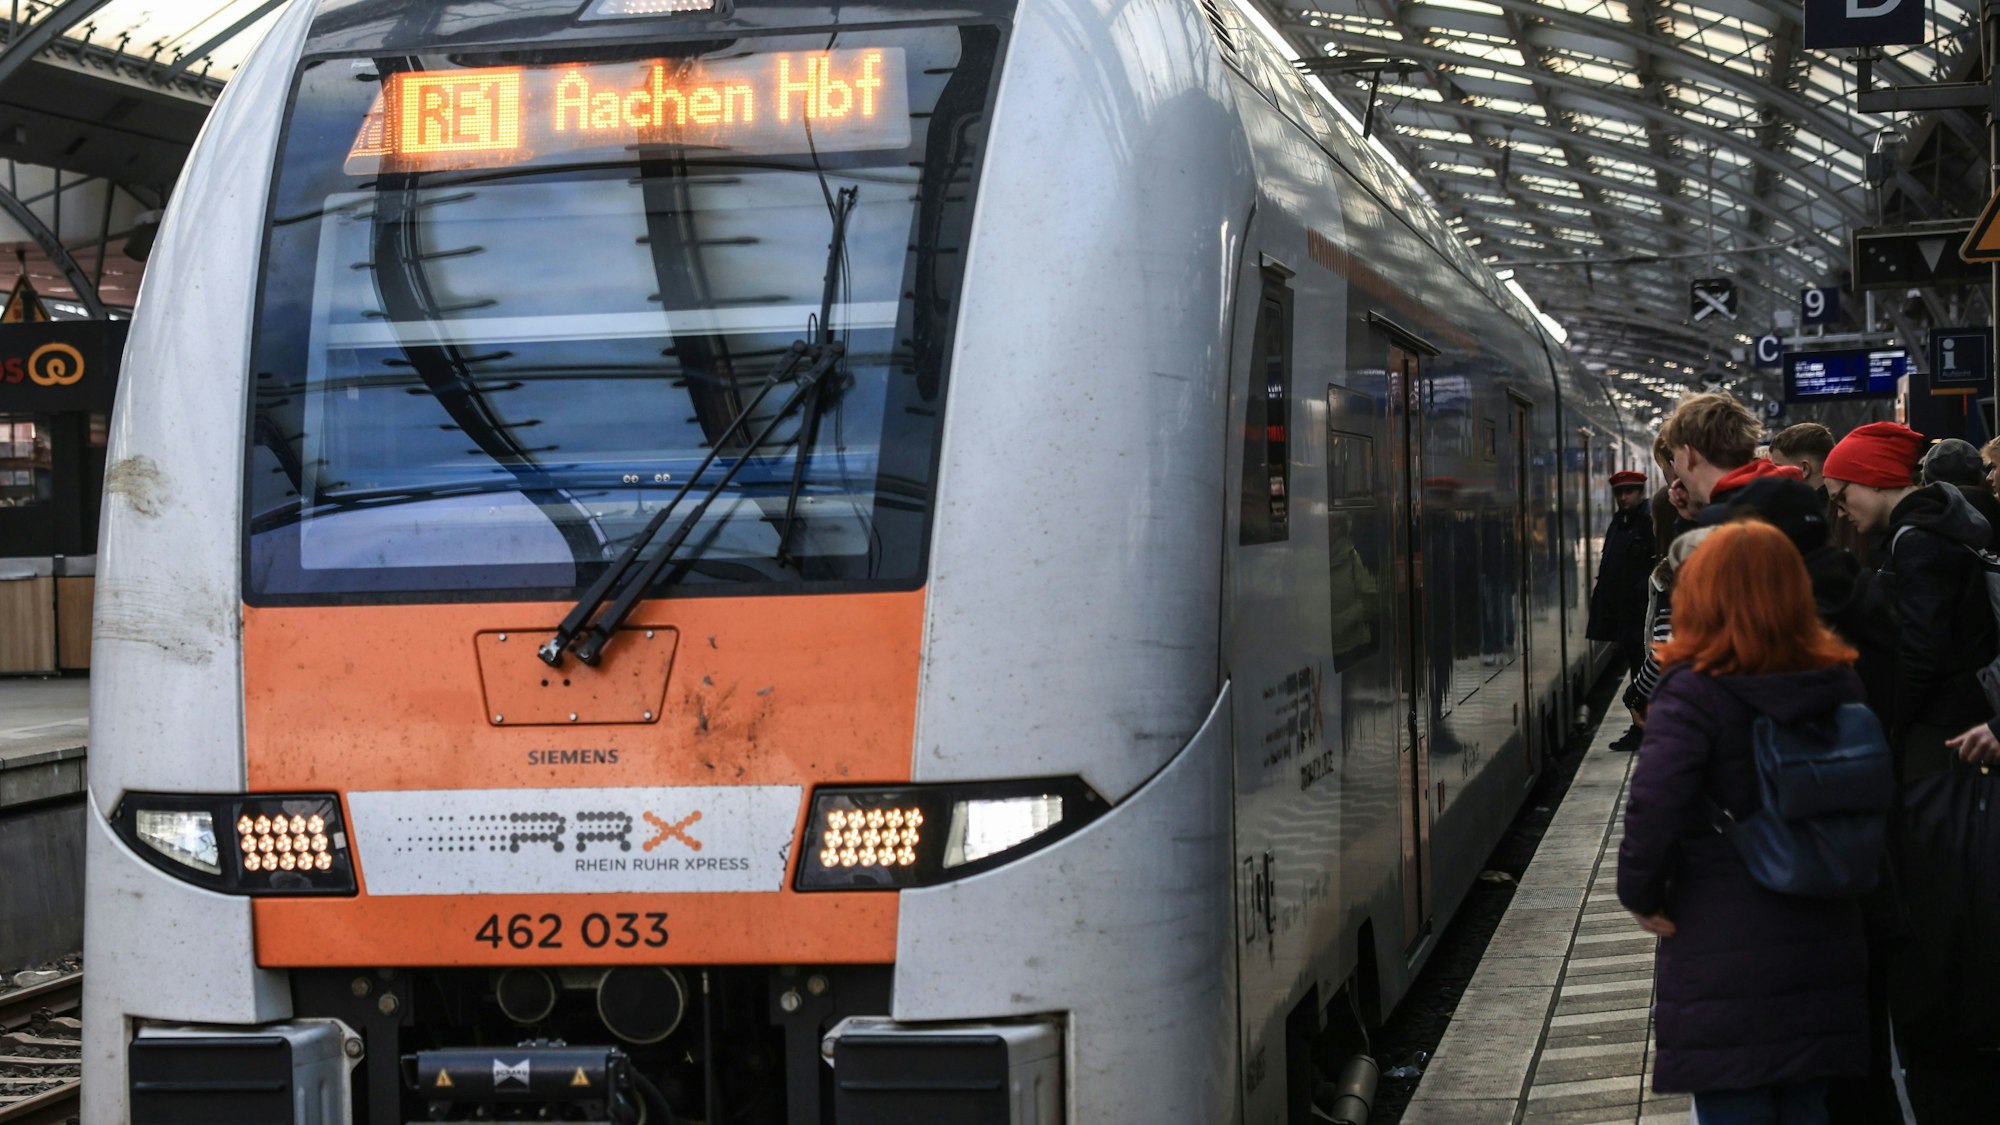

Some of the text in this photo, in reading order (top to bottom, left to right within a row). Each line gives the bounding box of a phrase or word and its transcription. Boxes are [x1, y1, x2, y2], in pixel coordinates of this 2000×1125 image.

[417, 53, 881, 145] RE1 Aachen Hbf
[1805, 289, 1825, 318] 9
[1758, 335, 1779, 362] C
[1769, 401, 1780, 417] 9
[528, 748, 620, 766] SIEMENS
[509, 810, 703, 854] RRX
[575, 857, 750, 872] RHEIN RUHR XPRESS
[475, 912, 669, 949] 462 033
